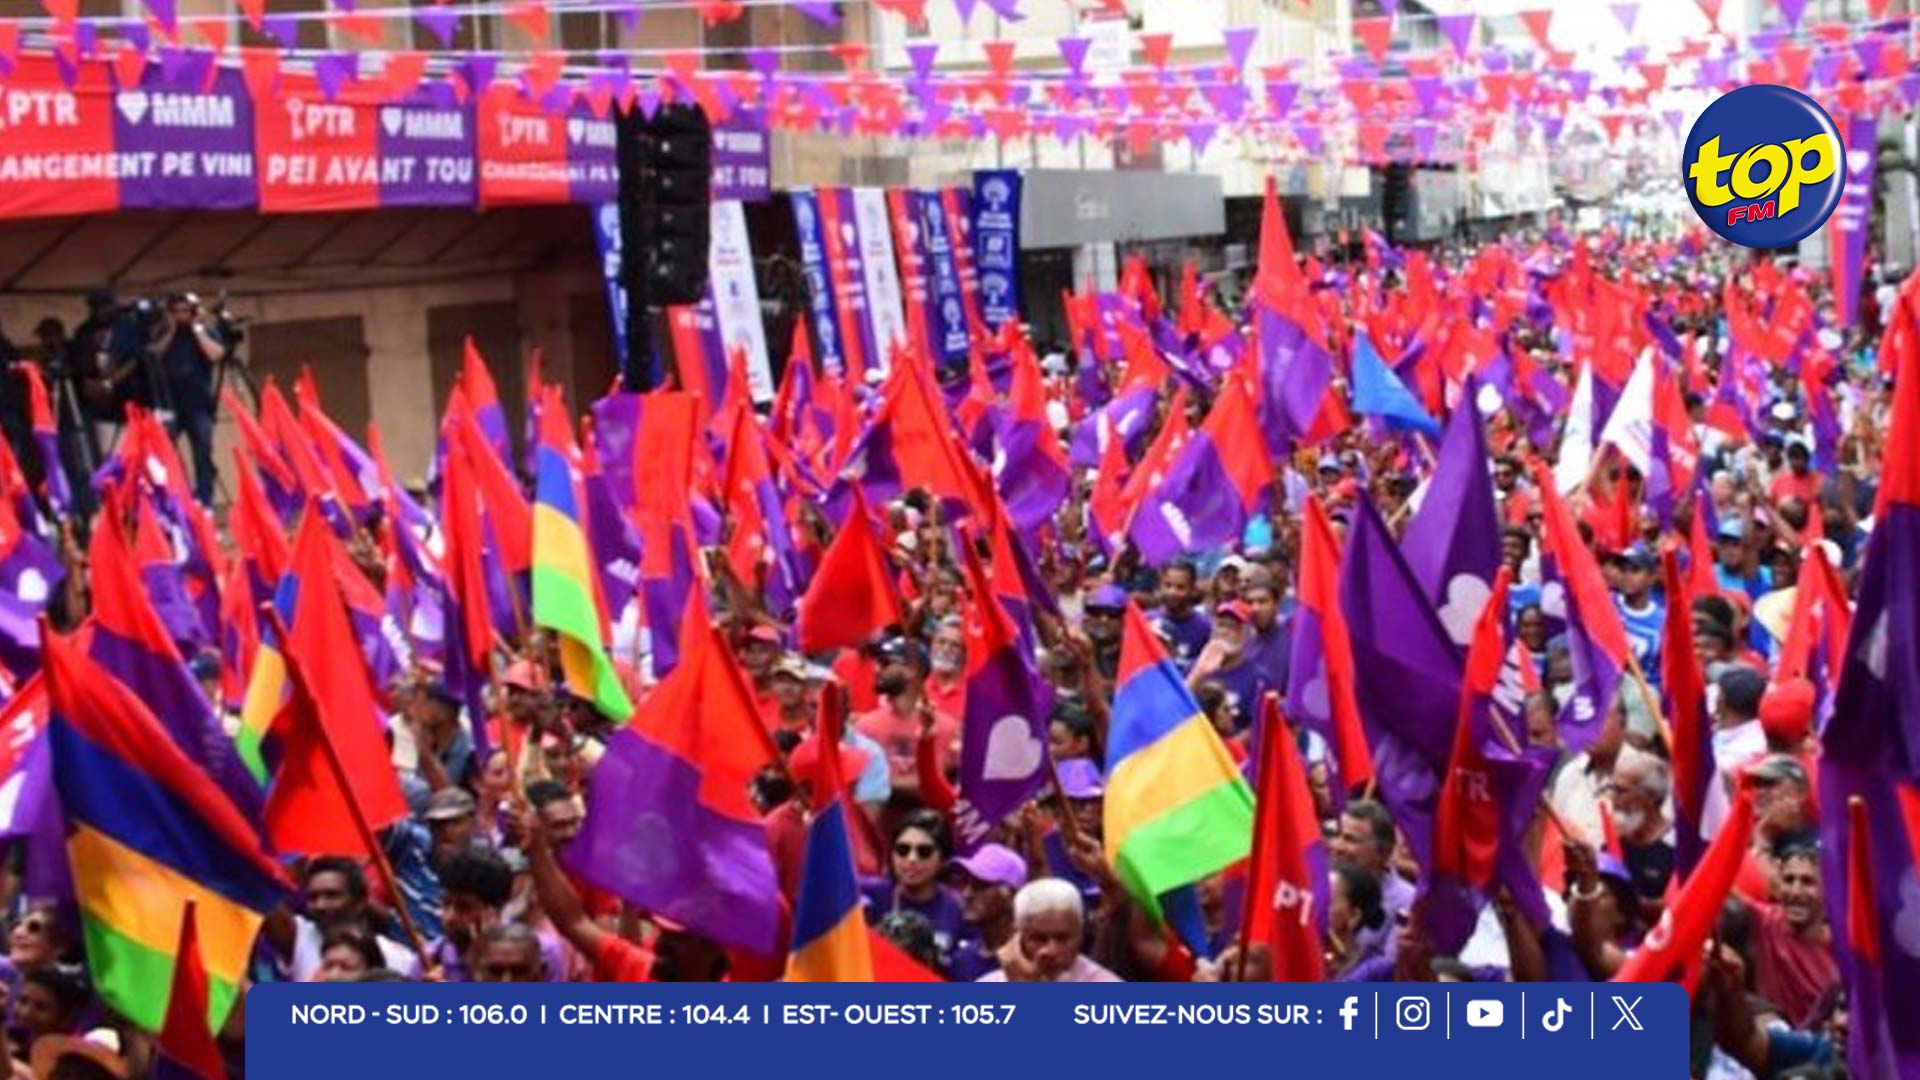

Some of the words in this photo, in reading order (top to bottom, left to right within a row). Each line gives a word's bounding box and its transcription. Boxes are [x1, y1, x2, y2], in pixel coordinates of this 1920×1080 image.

[7, 91, 79, 126] PTR
[151, 92, 235, 127] MMM
[306, 104, 356, 136] PTR
[405, 111, 463, 140] MMM
[511, 116, 549, 146] PTR
[0, 153, 156, 180] ANGEMENT
[162, 152, 194, 176] PE
[202, 153, 252, 176] VINI
[267, 154, 316, 184] PEI
[325, 155, 416, 184] AVANT
[425, 156, 474, 183] TOU
[1455, 765, 1492, 802] TR
[1273, 880, 1314, 927] PT
